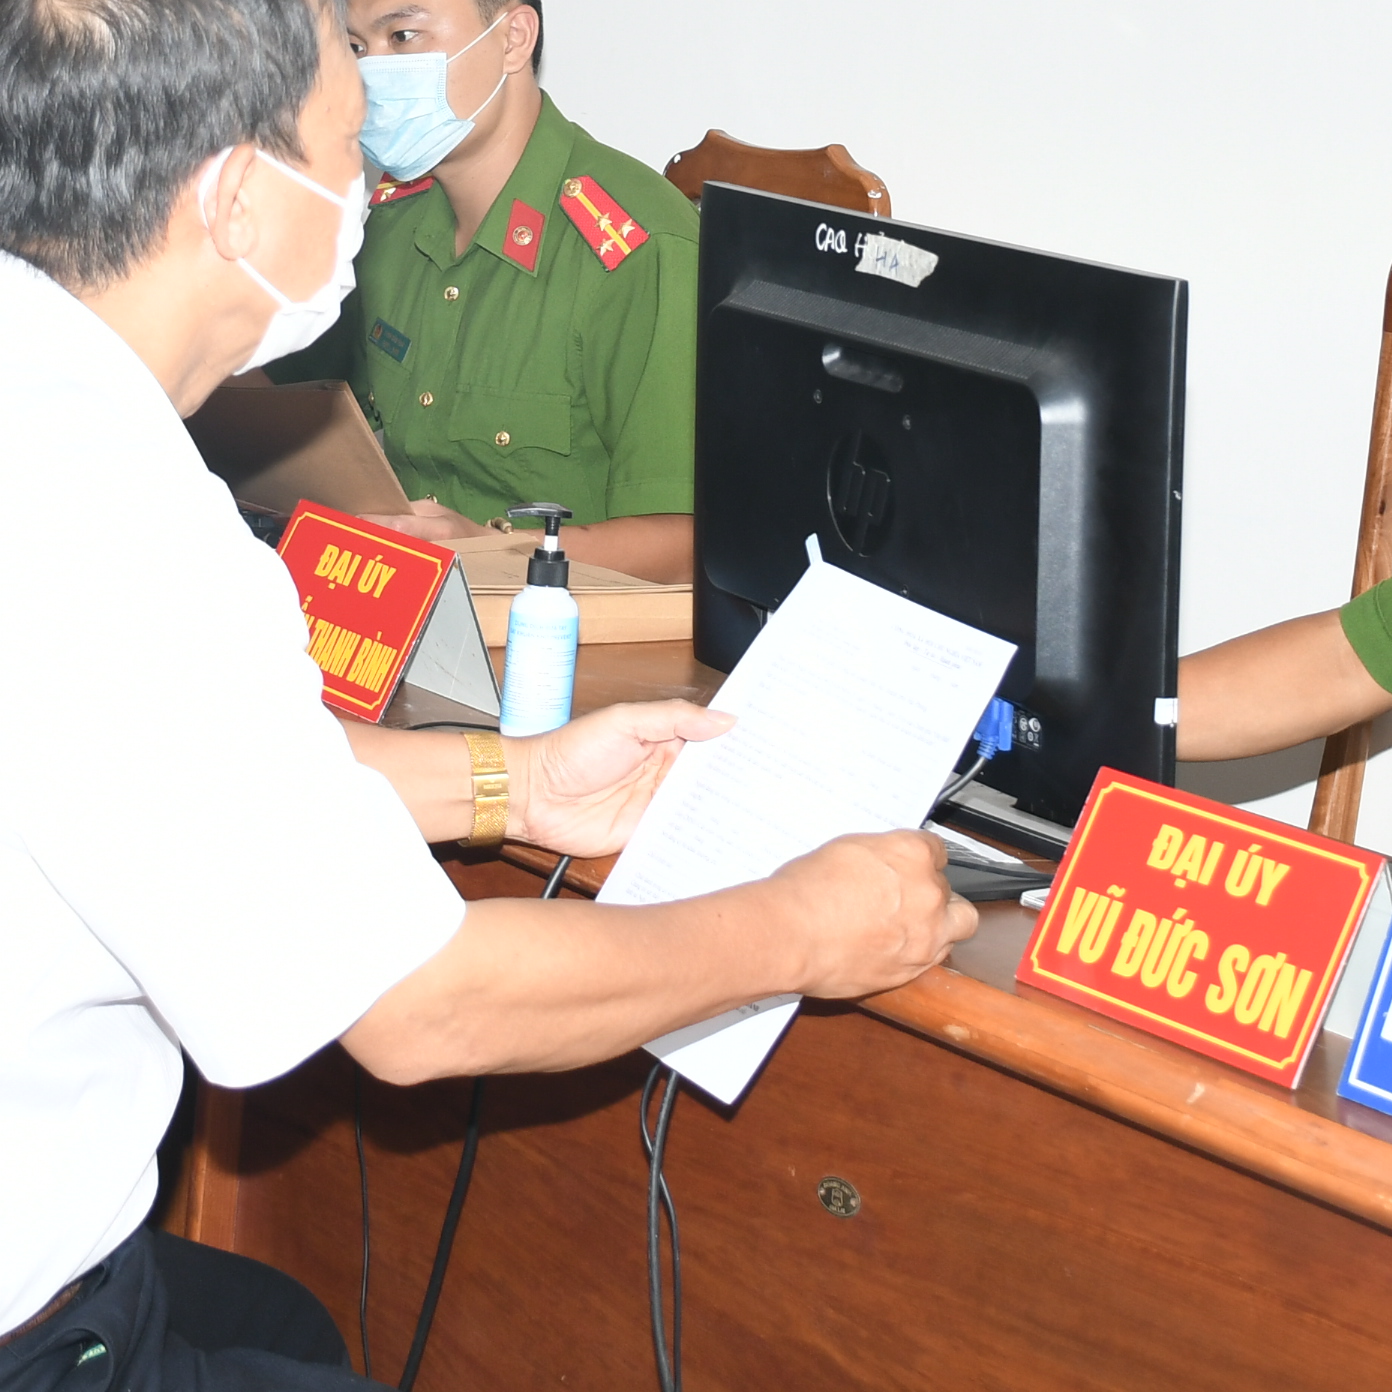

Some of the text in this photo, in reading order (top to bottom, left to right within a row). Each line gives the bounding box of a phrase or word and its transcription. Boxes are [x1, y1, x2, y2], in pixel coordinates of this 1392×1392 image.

[314, 543, 397, 599] ĐẠI ÚY
[306, 618, 398, 693] THANH BÌNH
[1147, 823, 1292, 907] ĐẠI ÚY
[1055, 884, 1314, 1040] VŨ ĐỨC SƠN
